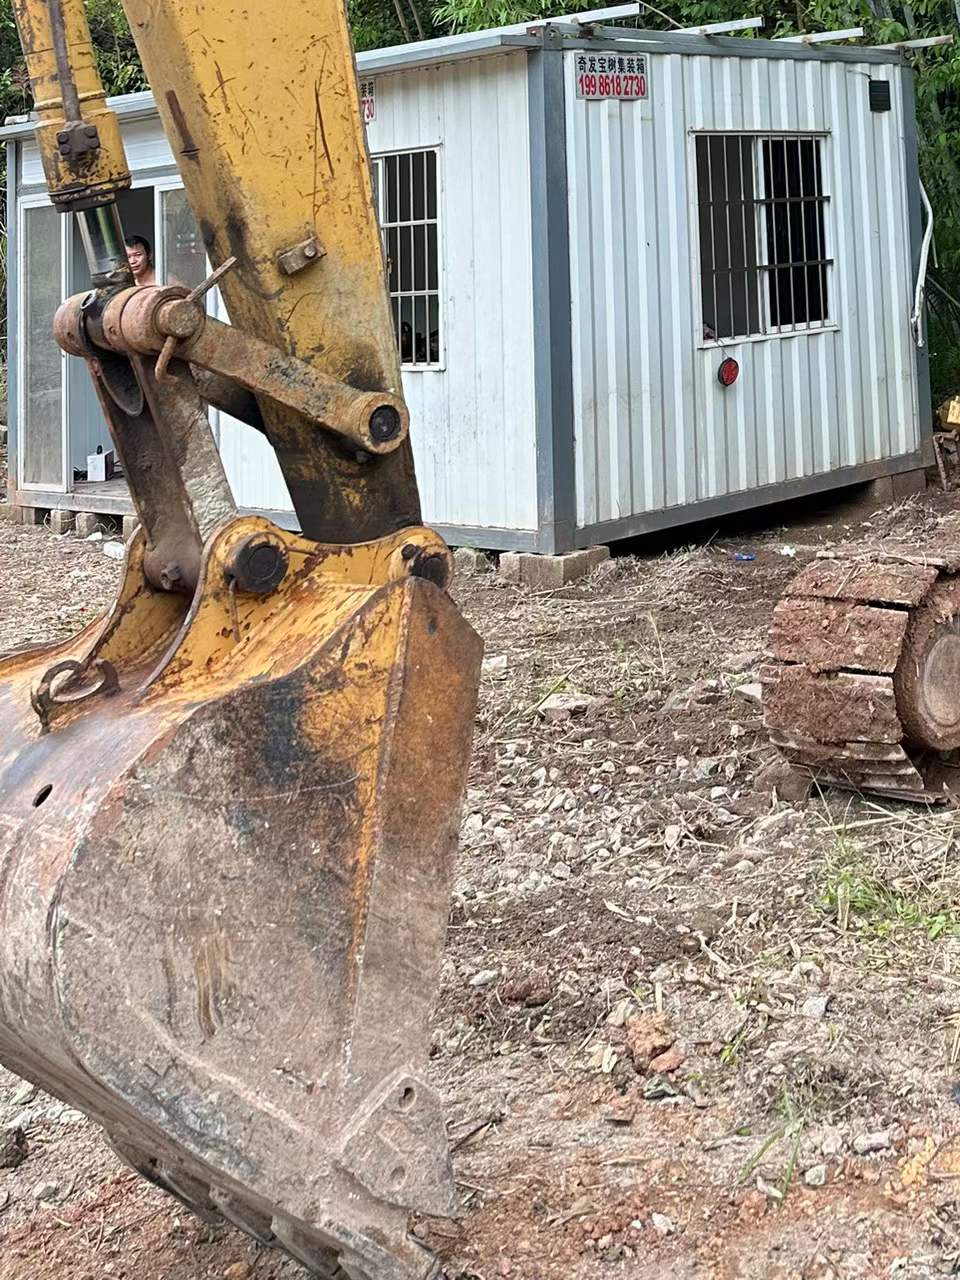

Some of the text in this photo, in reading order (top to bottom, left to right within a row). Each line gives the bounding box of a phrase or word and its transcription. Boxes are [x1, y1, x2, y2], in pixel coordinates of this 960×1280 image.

[577, 55, 645, 74] 奇发宝树集装箱
[578, 73, 646, 97] 199 8618 2730
